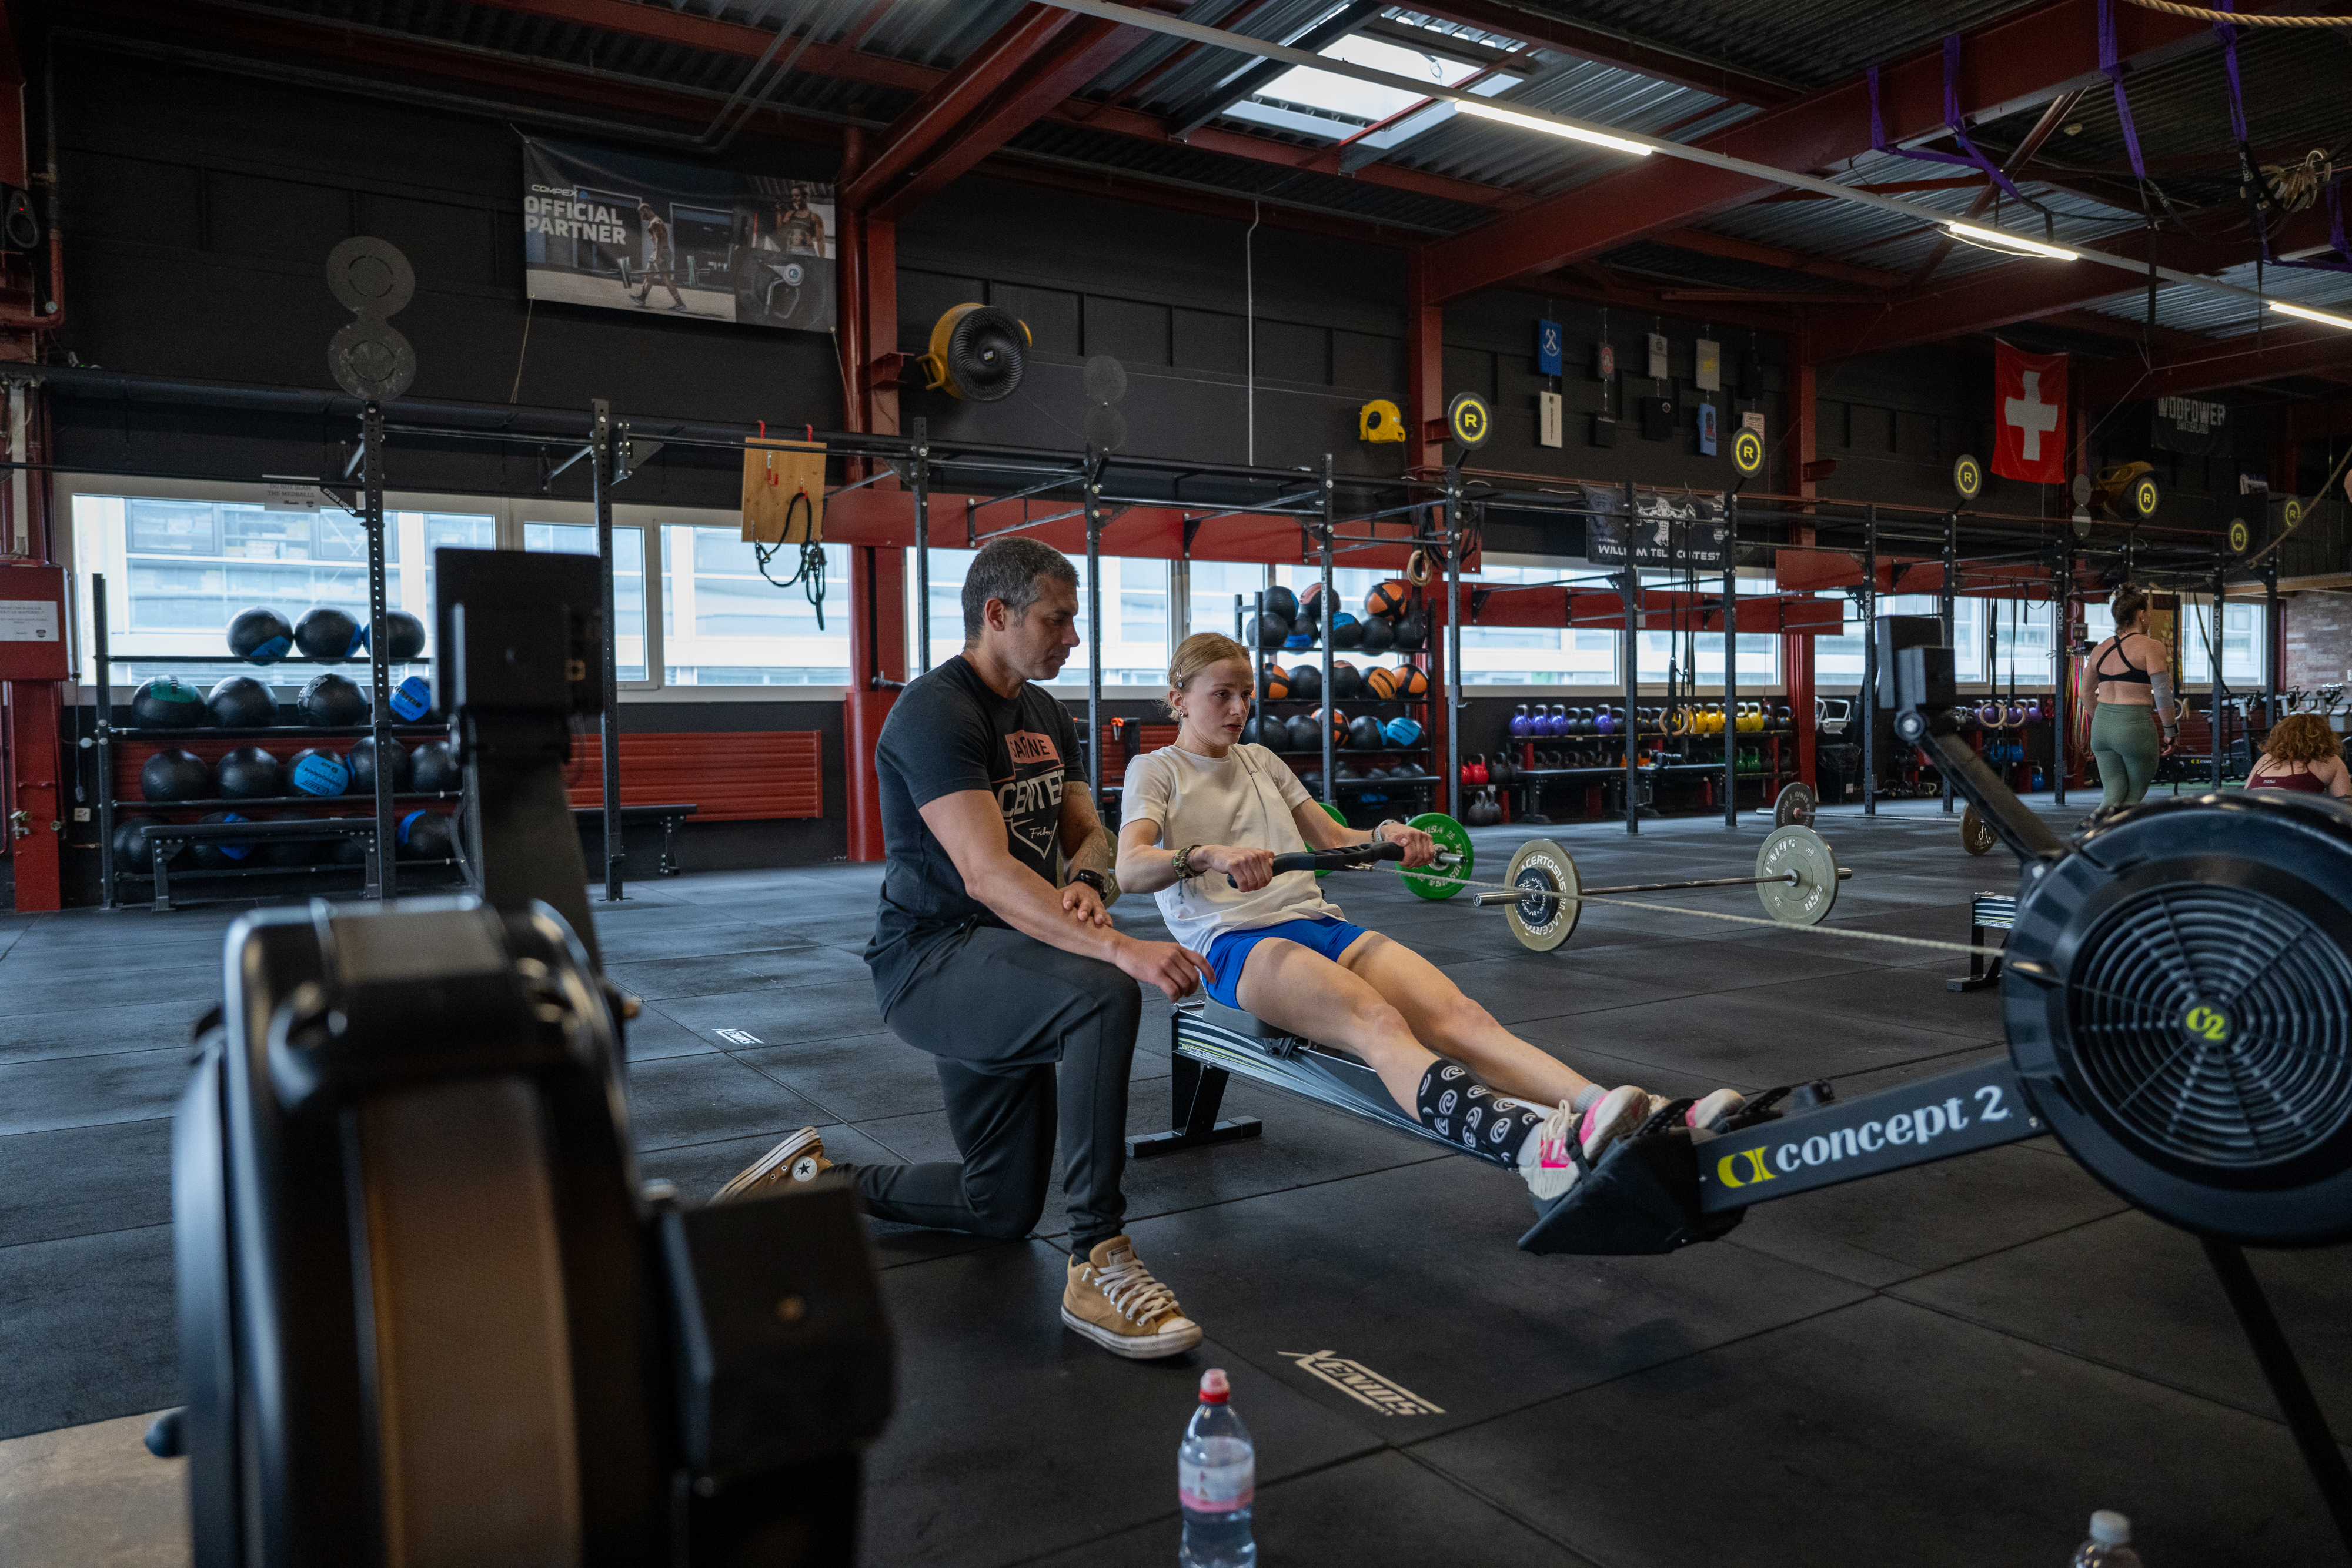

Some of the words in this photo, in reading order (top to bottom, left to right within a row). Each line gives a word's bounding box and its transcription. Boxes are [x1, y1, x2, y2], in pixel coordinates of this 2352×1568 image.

[531, 184, 577, 197] COMPEX
[524, 196, 623, 226] OFFICIAL
[524, 215, 626, 245] PARTNER
[1465, 413, 1477, 427] R
[1743, 446, 1753, 459] R
[1964, 472, 1972, 483] R
[2144, 493, 2151, 503] R
[2290, 510, 2296, 519] R
[2236, 532, 2242, 541] R
[1598, 545, 1648, 556] WILLIM
[1651, 547, 1669, 557] TEL
[1676, 550, 1720, 560] CTEST
[1766, 838, 1796, 877] ENIOS
[1517, 855, 1566, 891] ACERTOSUS
[1804, 884, 1822, 911] USA
[1518, 911, 1563, 935] LACERTO
[2186, 1006, 2226, 1040] C2
[1188, 1047, 1204, 1055] concept
[1775, 1096, 1969, 1172] concept
[1974, 1085, 2010, 1121] 2
